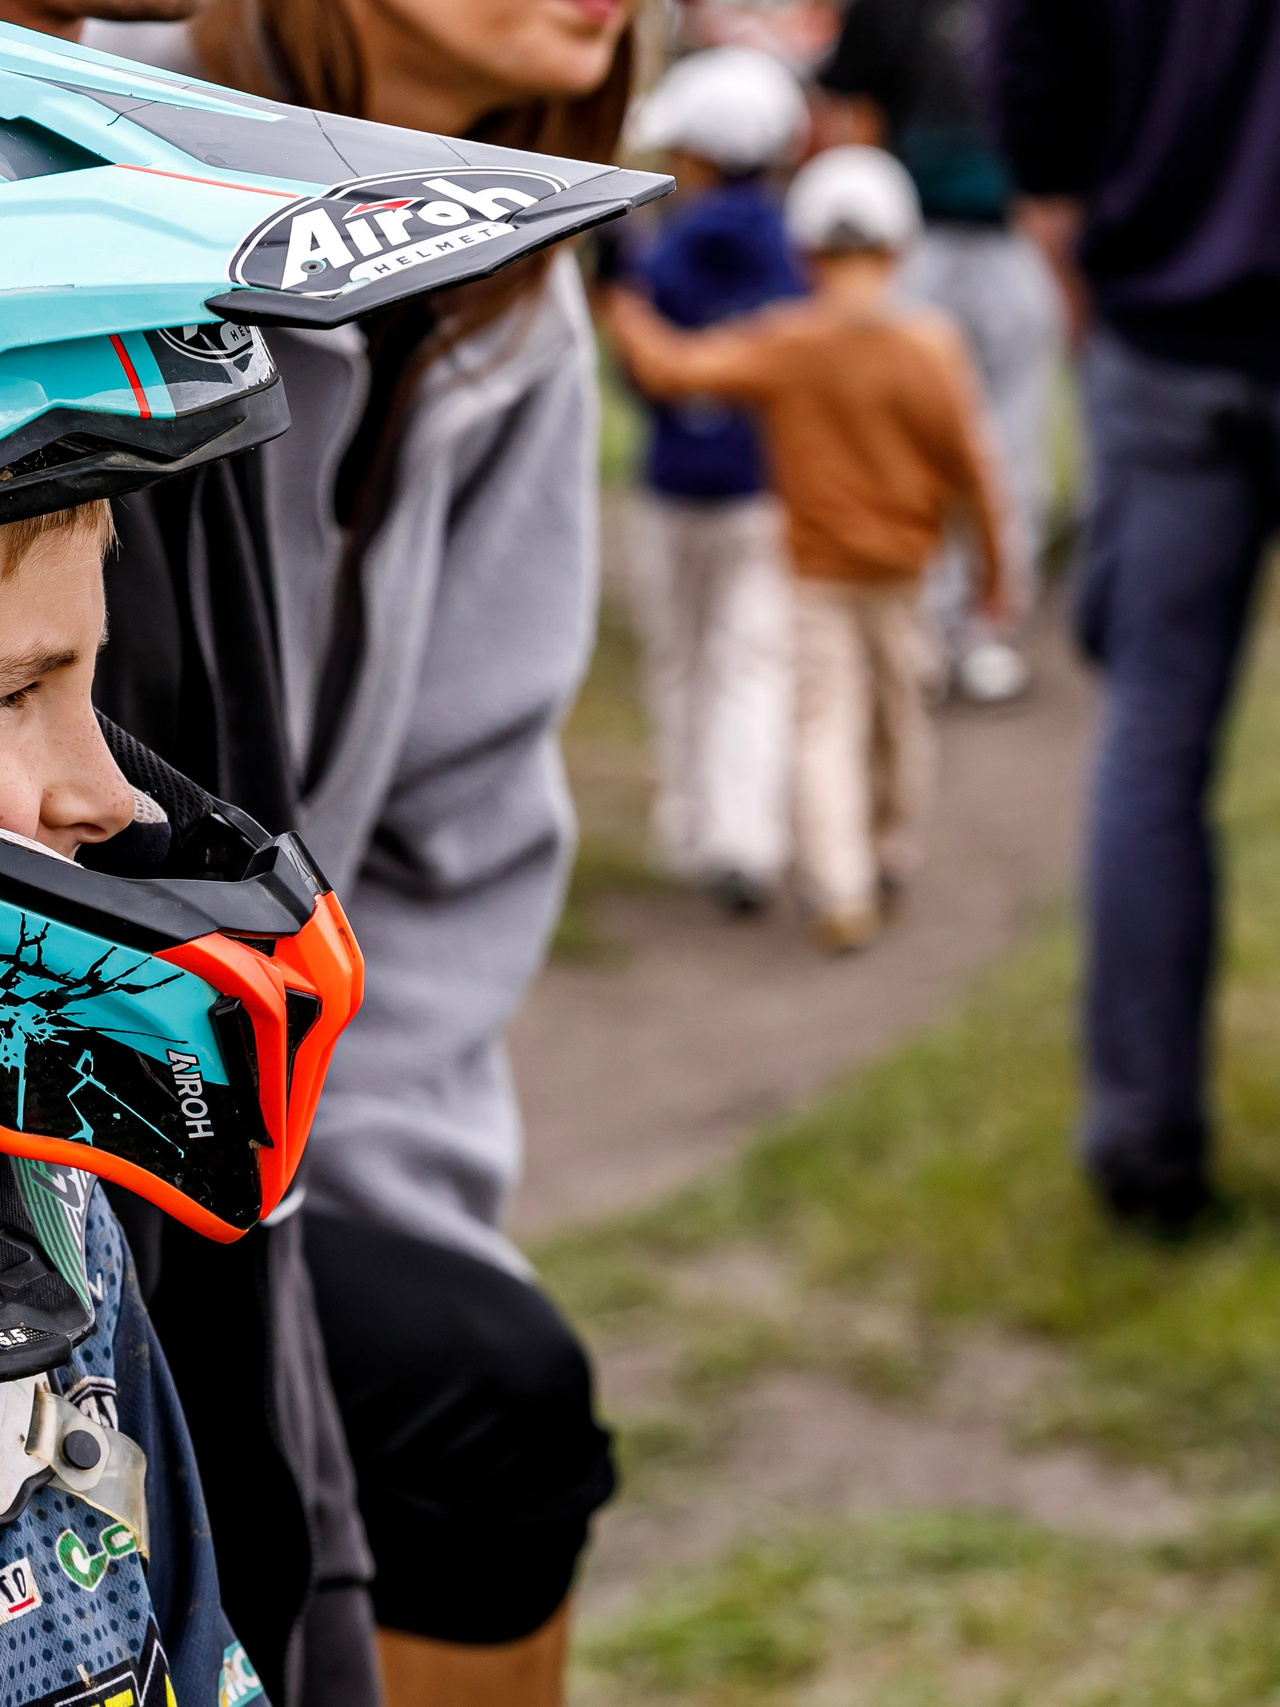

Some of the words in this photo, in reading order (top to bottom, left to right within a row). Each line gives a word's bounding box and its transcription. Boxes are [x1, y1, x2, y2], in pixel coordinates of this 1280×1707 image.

[280, 177, 540, 291] Airoh
[373, 227, 494, 275] HELMET
[167, 1050, 215, 1139] AIROH
